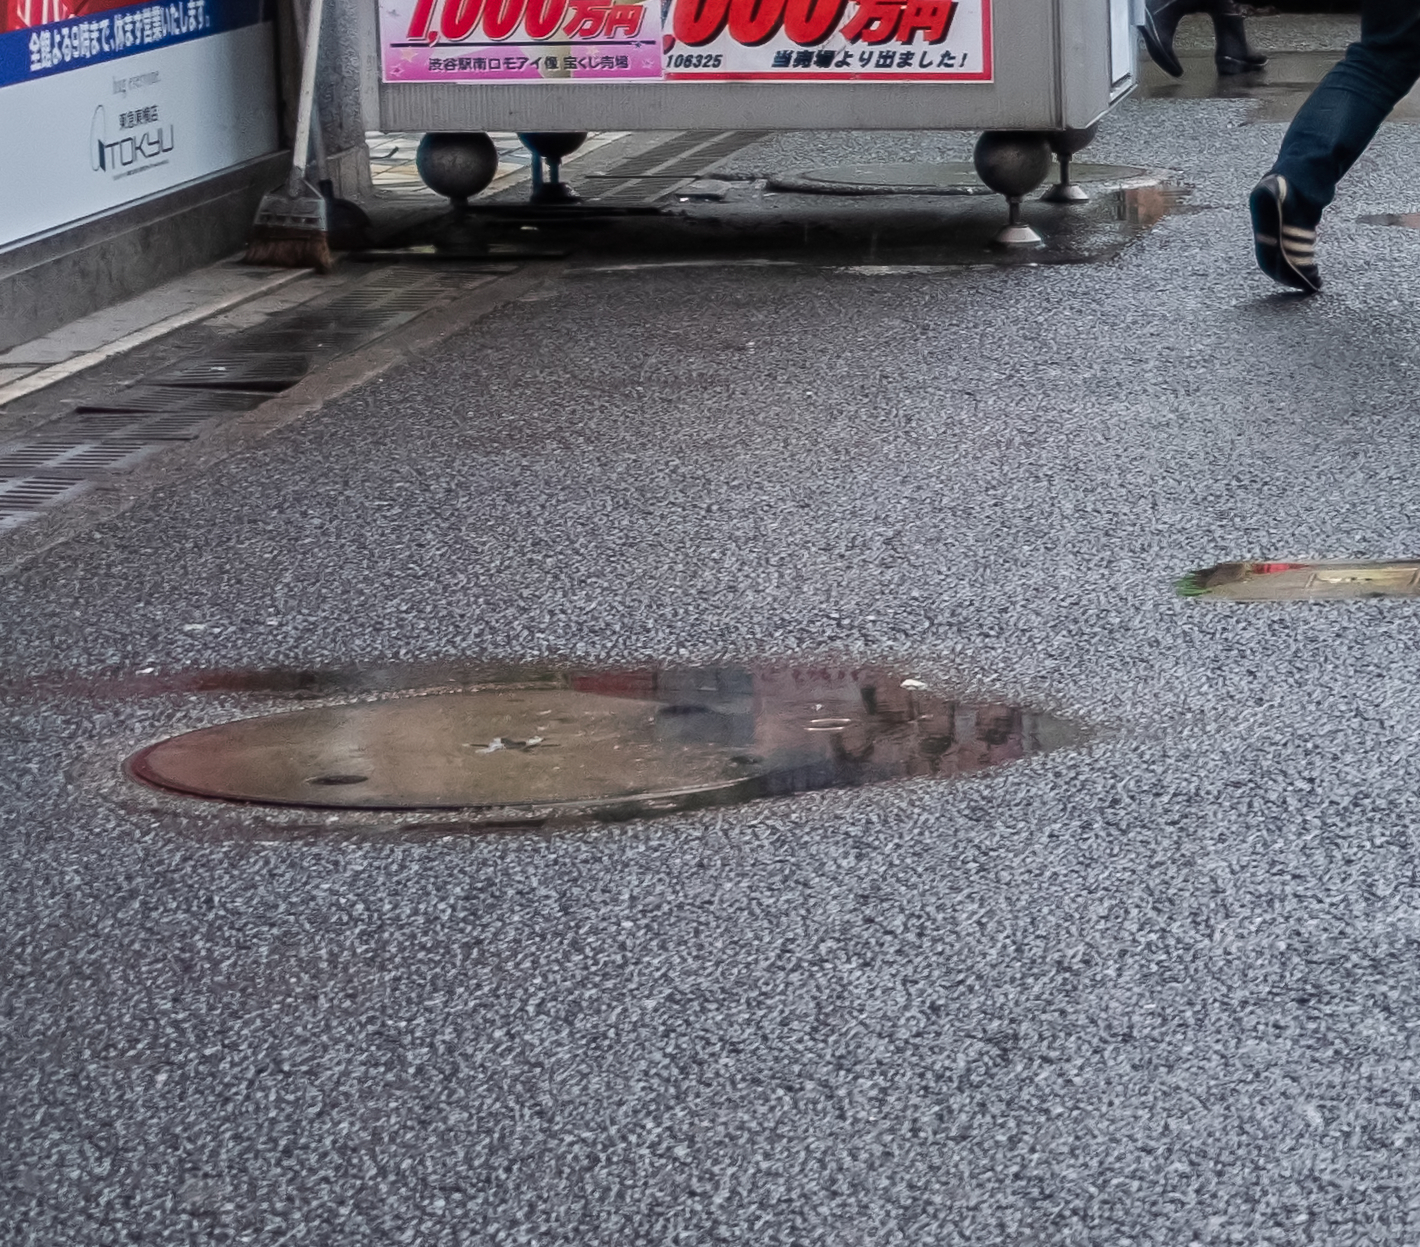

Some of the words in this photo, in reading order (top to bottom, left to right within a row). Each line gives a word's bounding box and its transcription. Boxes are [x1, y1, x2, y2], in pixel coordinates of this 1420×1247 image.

[564, 55, 629, 70] 宝くじ売場
[666, 54, 724, 69] 106325
[771, 50, 967, 69] 当売場より出ました!
[105, 124, 175, 171] TOKYU
